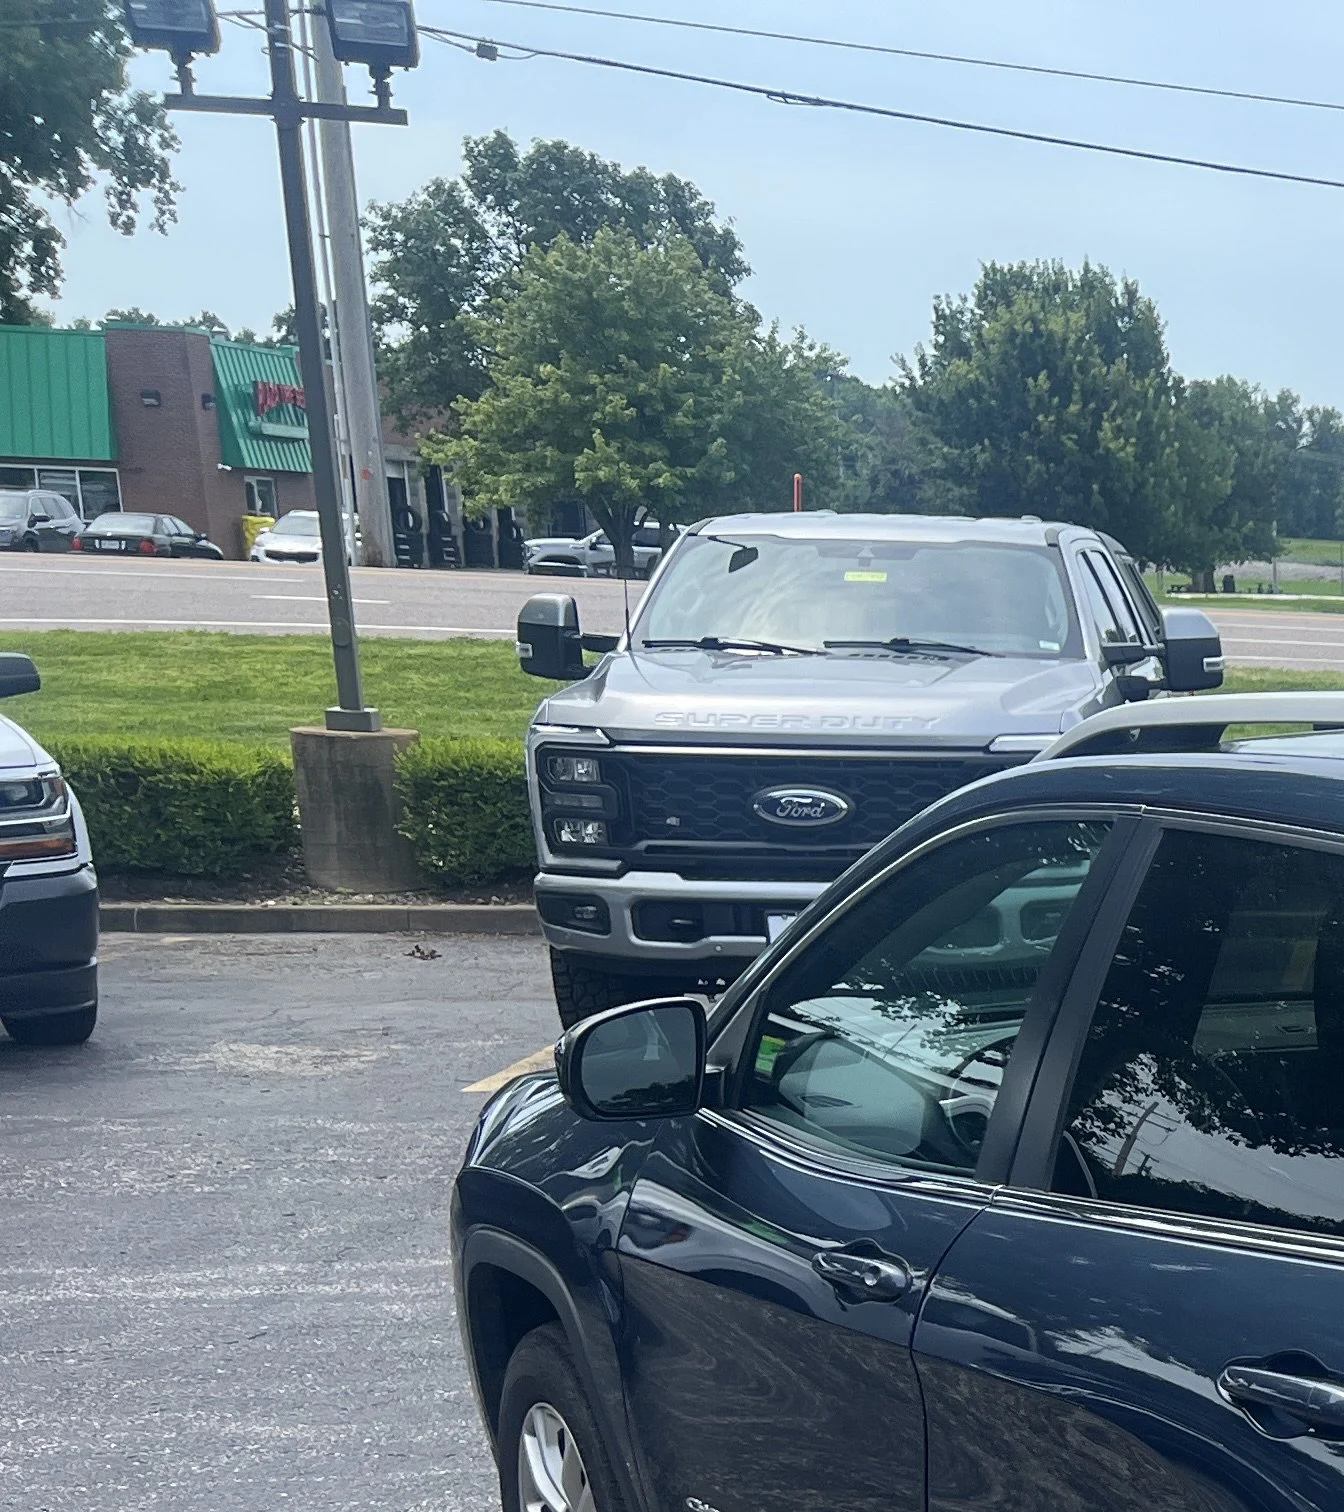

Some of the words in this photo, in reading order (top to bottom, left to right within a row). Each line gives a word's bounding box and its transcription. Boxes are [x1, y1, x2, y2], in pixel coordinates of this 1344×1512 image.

[654, 711, 812, 728] SUPER
[820, 714, 942, 730] DUTY
[776, 797, 826, 818] Ford
